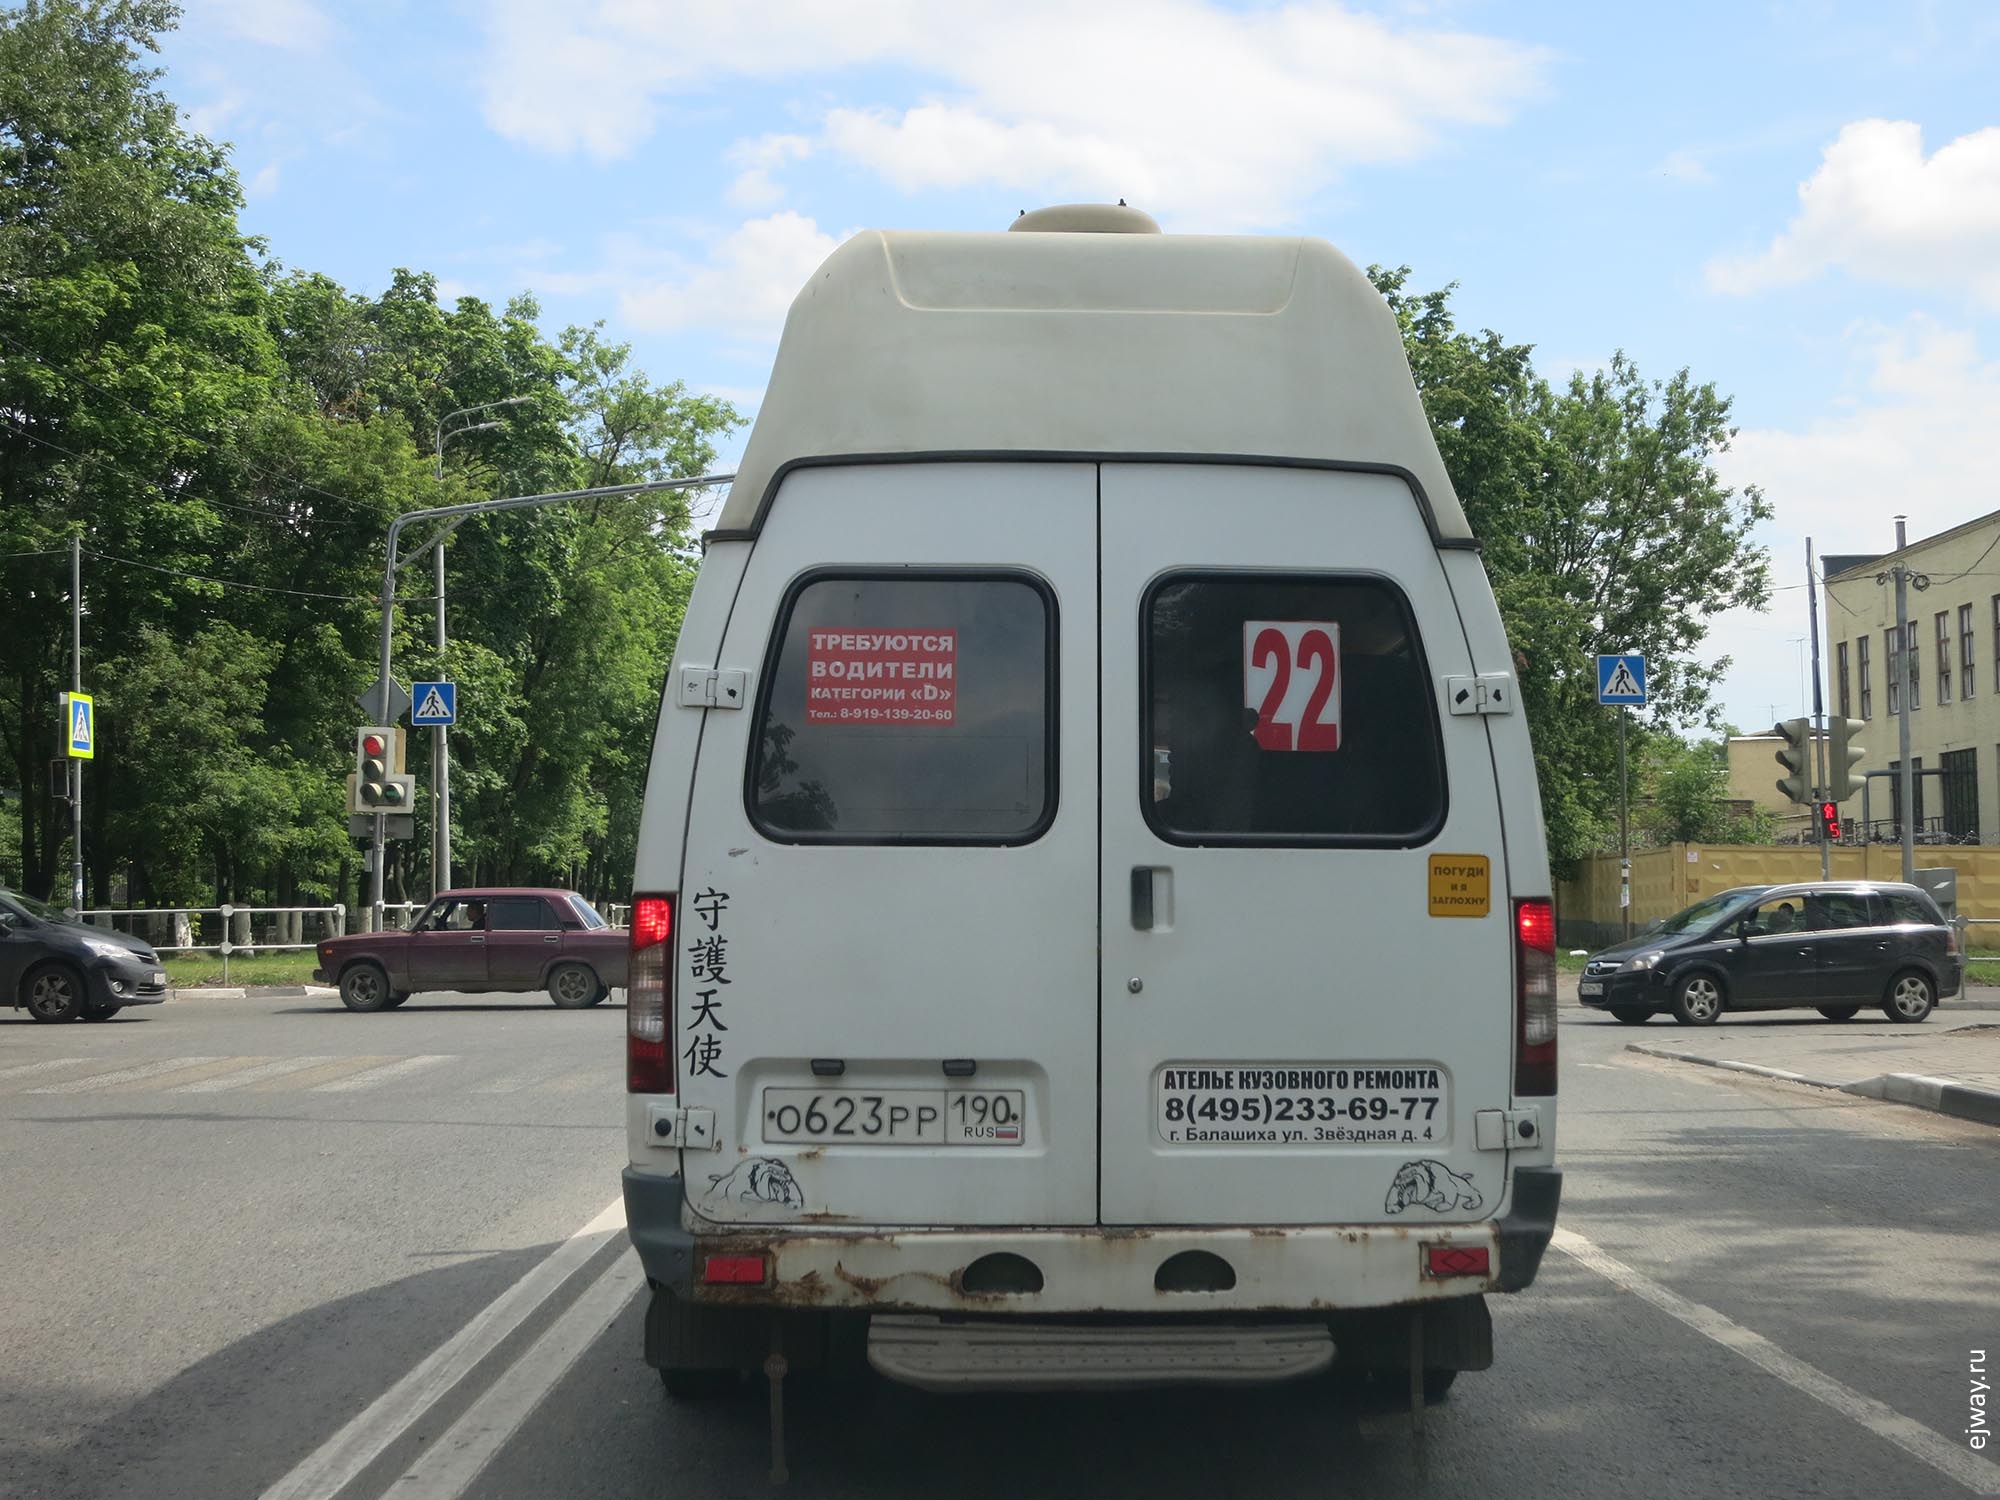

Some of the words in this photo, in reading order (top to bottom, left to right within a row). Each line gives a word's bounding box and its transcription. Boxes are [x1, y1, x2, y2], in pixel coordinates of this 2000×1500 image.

[812, 634, 953, 652] ТРЕБУЮТСЯ
[812, 661, 953, 680] ВОДИТЕЛИ
[811, 687, 905, 700] КАТЕГОРИИ
[1252, 628, 1338, 751] 22
[810, 709, 837, 718] Тел.:
[840, 708, 953, 720] 8-919-139-20-60
[1829, 822, 1841, 838] 5
[1433, 866, 1484, 878] ПОГУДИ
[1432, 896, 1486, 905] ЗАГЛОХНУ
[683, 887, 732, 1078] 守護天使
[1164, 1070, 1234, 1090] АТЕЛЬЕ
[1239, 1070, 1349, 1090] КУЗОВНОГО
[1354, 1070, 1440, 1090] РЕМОНТА
[952, 1095, 1012, 1124] 190
[1165, 1094, 1440, 1124] 8(495)233-69-77
[964, 1127, 995, 1138] RUS
[1170, 1129, 1180, 1141] г.
[1186, 1126, 1277, 1141] Балашиха
[1282, 1129, 1308, 1143] ул.
[1314, 1126, 1397, 1142] Звёздная
[1402, 1128, 1418, 1142] д.
[1423, 1126, 1433, 1140] 4
